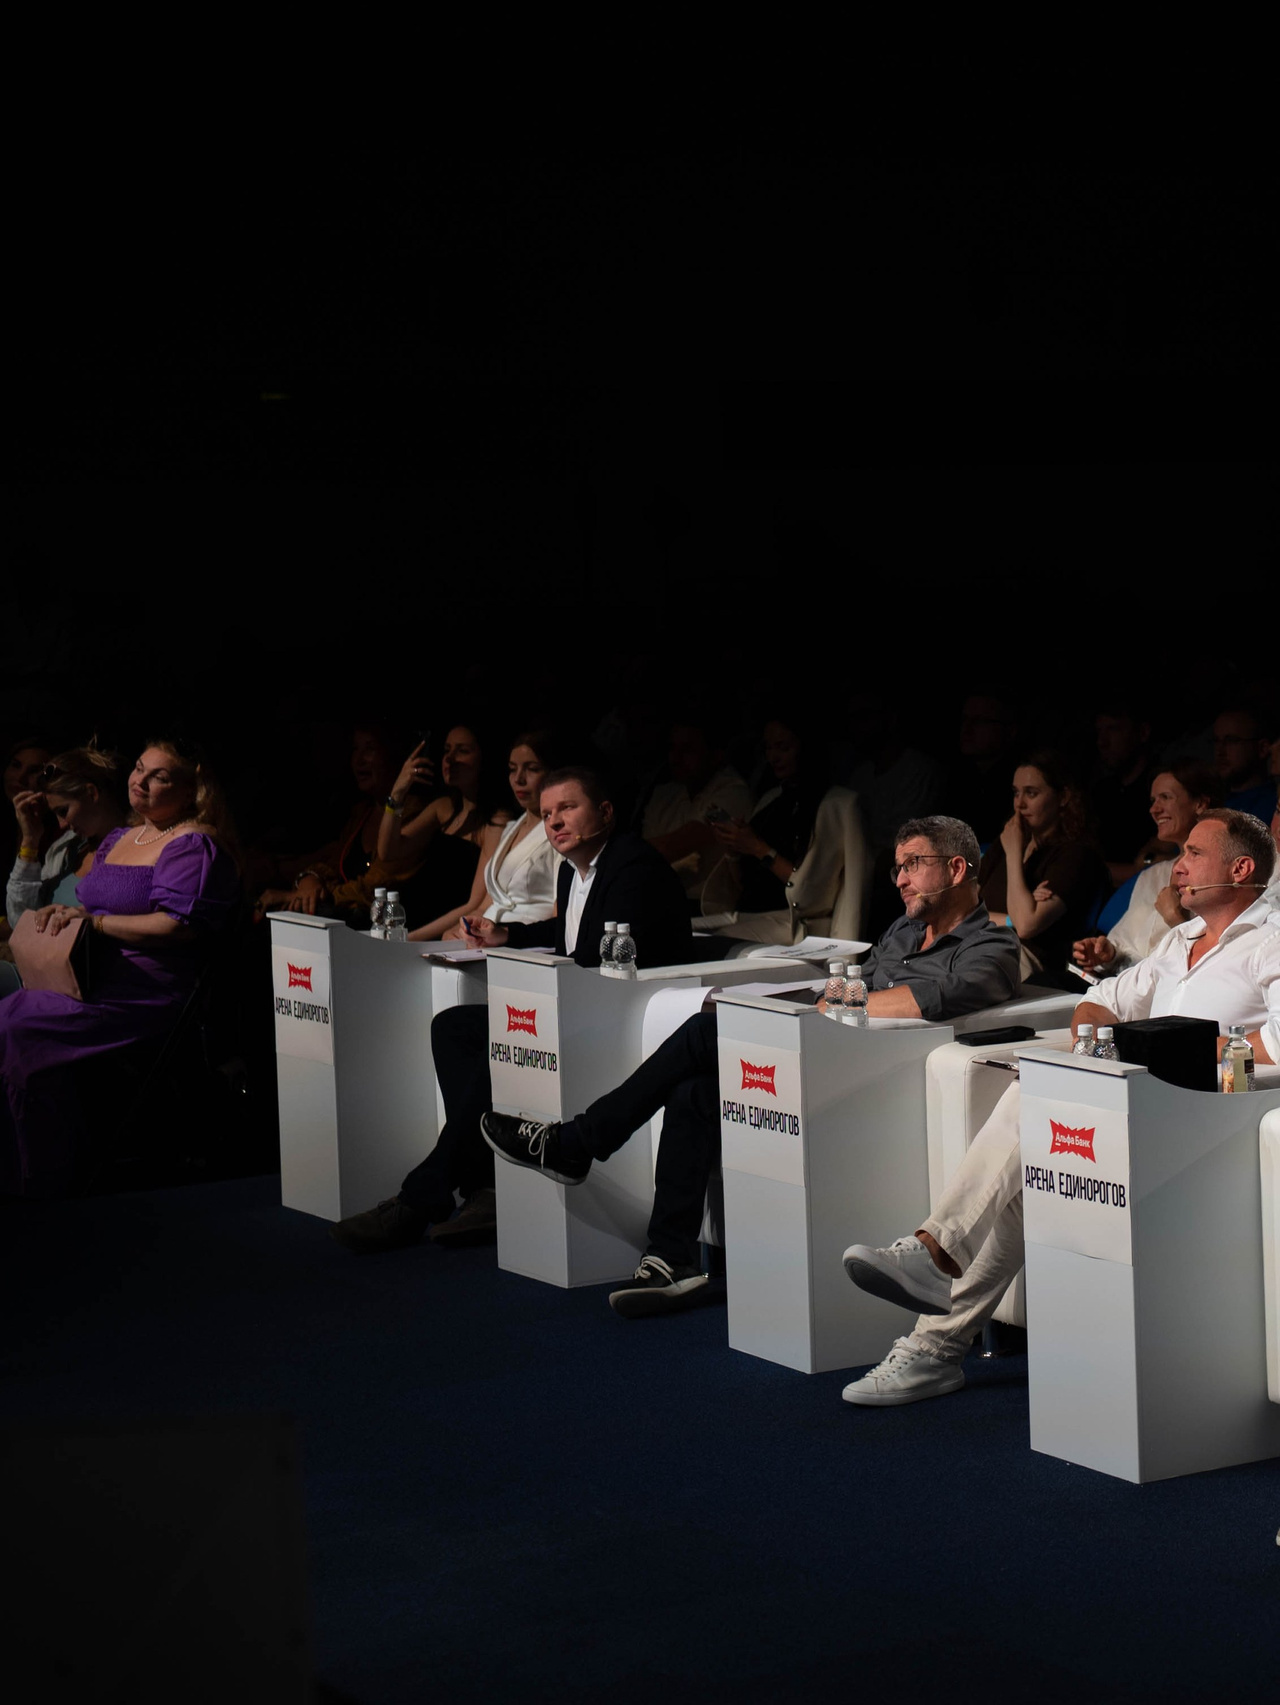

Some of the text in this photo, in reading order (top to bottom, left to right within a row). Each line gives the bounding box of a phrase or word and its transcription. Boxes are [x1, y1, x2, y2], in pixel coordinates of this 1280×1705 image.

[275, 996, 330, 1024] АРЕНА ЕДИНОРОГОВ
[491, 1042, 557, 1072] АРЕНА ЕДИНОРОГОВ
[722, 1100, 800, 1136] АРЕНА ЕДИНОРОГОВ
[1055, 1131, 1091, 1148] Альфа Банк
[1025, 1165, 1126, 1208] АРЕНА ЕДИНОРОГОВ
